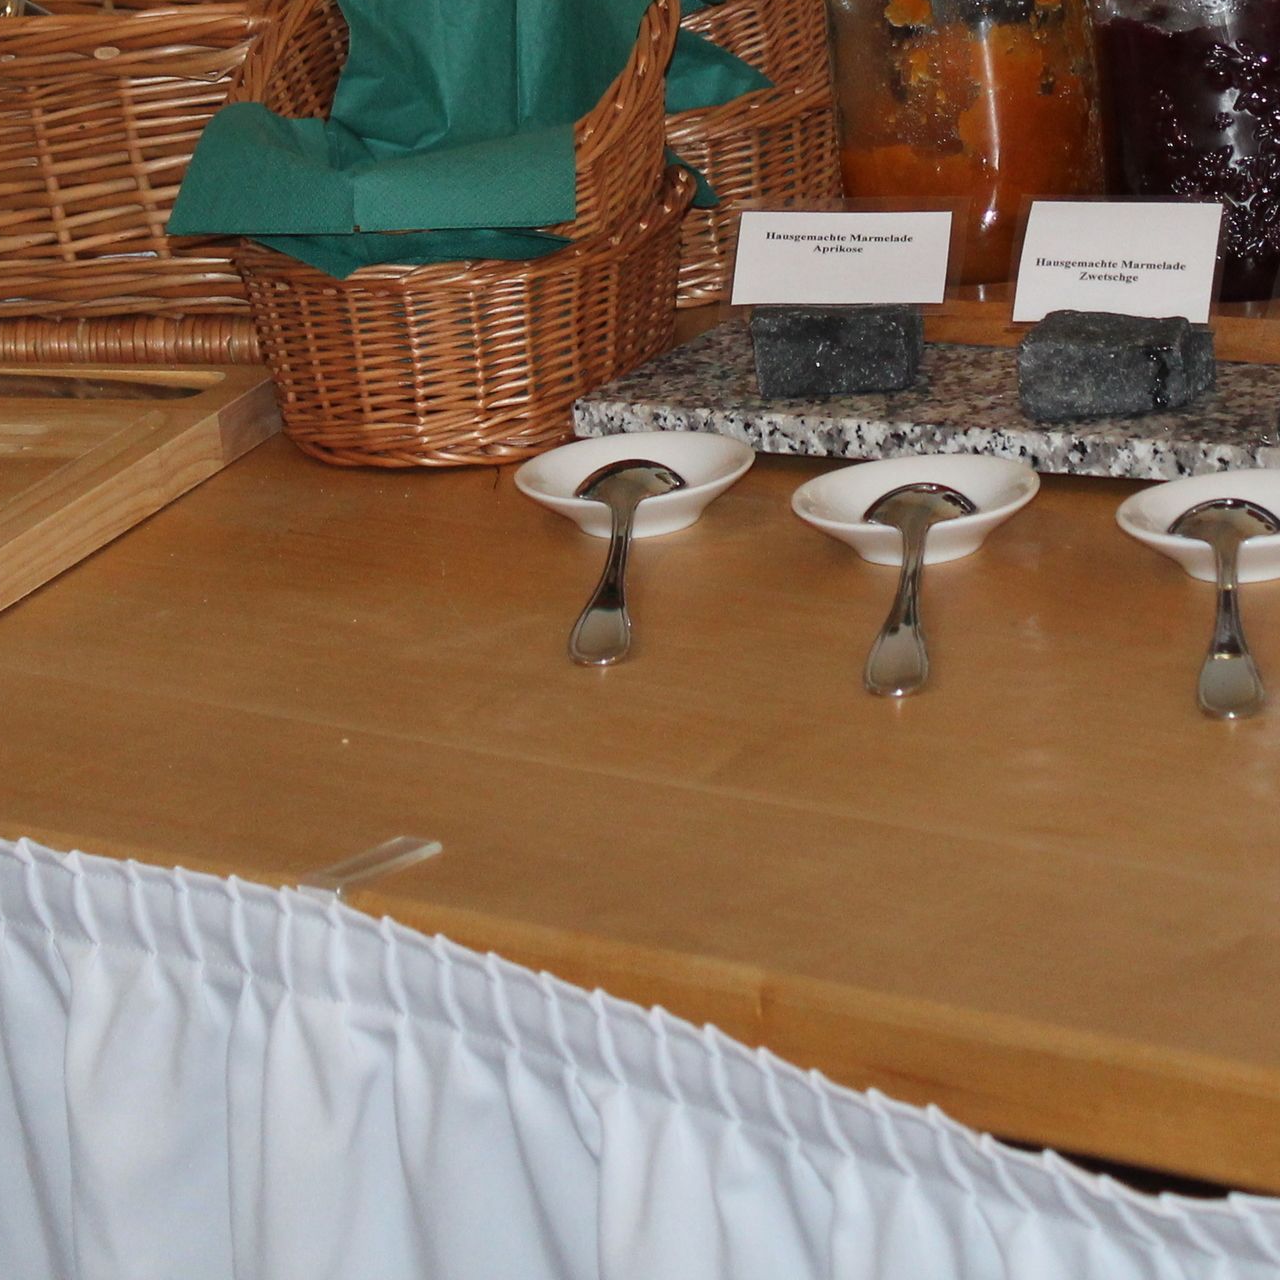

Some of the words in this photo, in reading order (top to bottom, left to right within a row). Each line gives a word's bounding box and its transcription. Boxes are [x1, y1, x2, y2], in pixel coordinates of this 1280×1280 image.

[766, 231, 847, 242] Hausgemachte
[850, 233, 914, 243] Marmelade
[813, 244, 864, 254] Aprikose
[1036, 257, 1119, 270] Hausgemachte
[1121, 260, 1187, 271] Marmelade
[1079, 271, 1140, 284] Zwetschge
